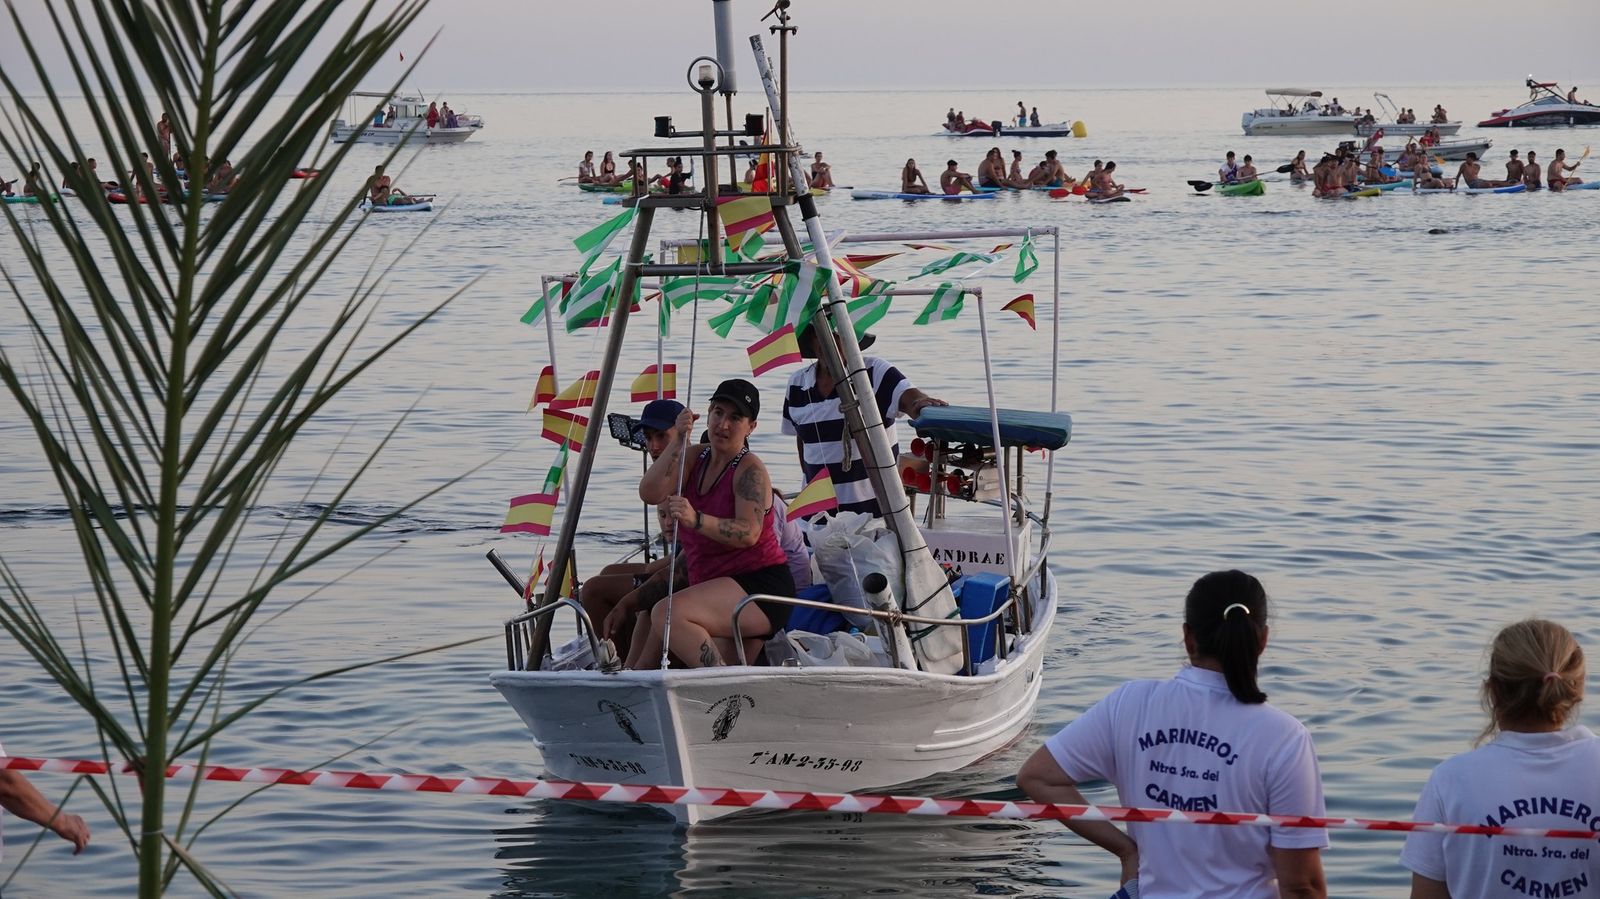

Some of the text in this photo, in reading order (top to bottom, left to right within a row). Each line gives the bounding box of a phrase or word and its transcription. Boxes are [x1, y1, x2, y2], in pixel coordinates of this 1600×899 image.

[1138, 728, 1239, 766] MARINEROS
[1202, 770, 1220, 782] del
[1145, 783, 1218, 812] CARMEN
[1503, 844, 1590, 860] Ntra. Sra. del
[1500, 869, 1589, 899] CARMEN
